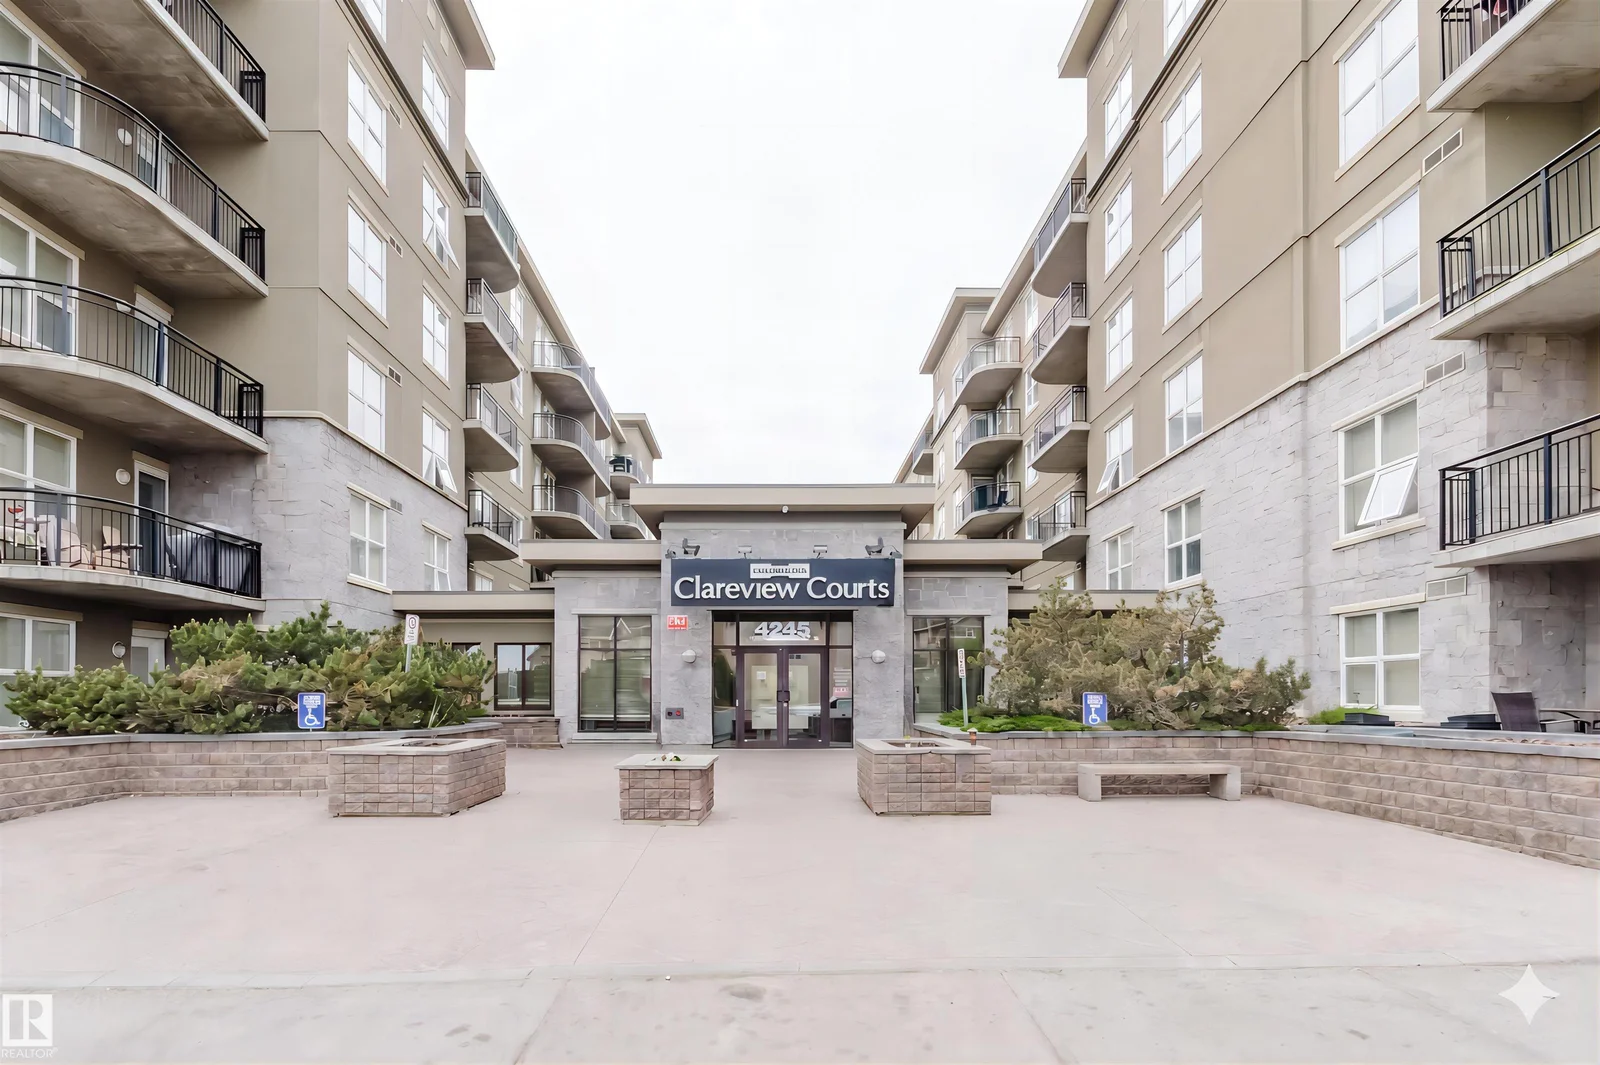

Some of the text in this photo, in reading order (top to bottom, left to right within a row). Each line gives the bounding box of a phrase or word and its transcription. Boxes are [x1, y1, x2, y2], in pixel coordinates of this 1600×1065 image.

[674, 575, 890, 600] Clareview Courts
[754, 621, 811, 638] 4245
